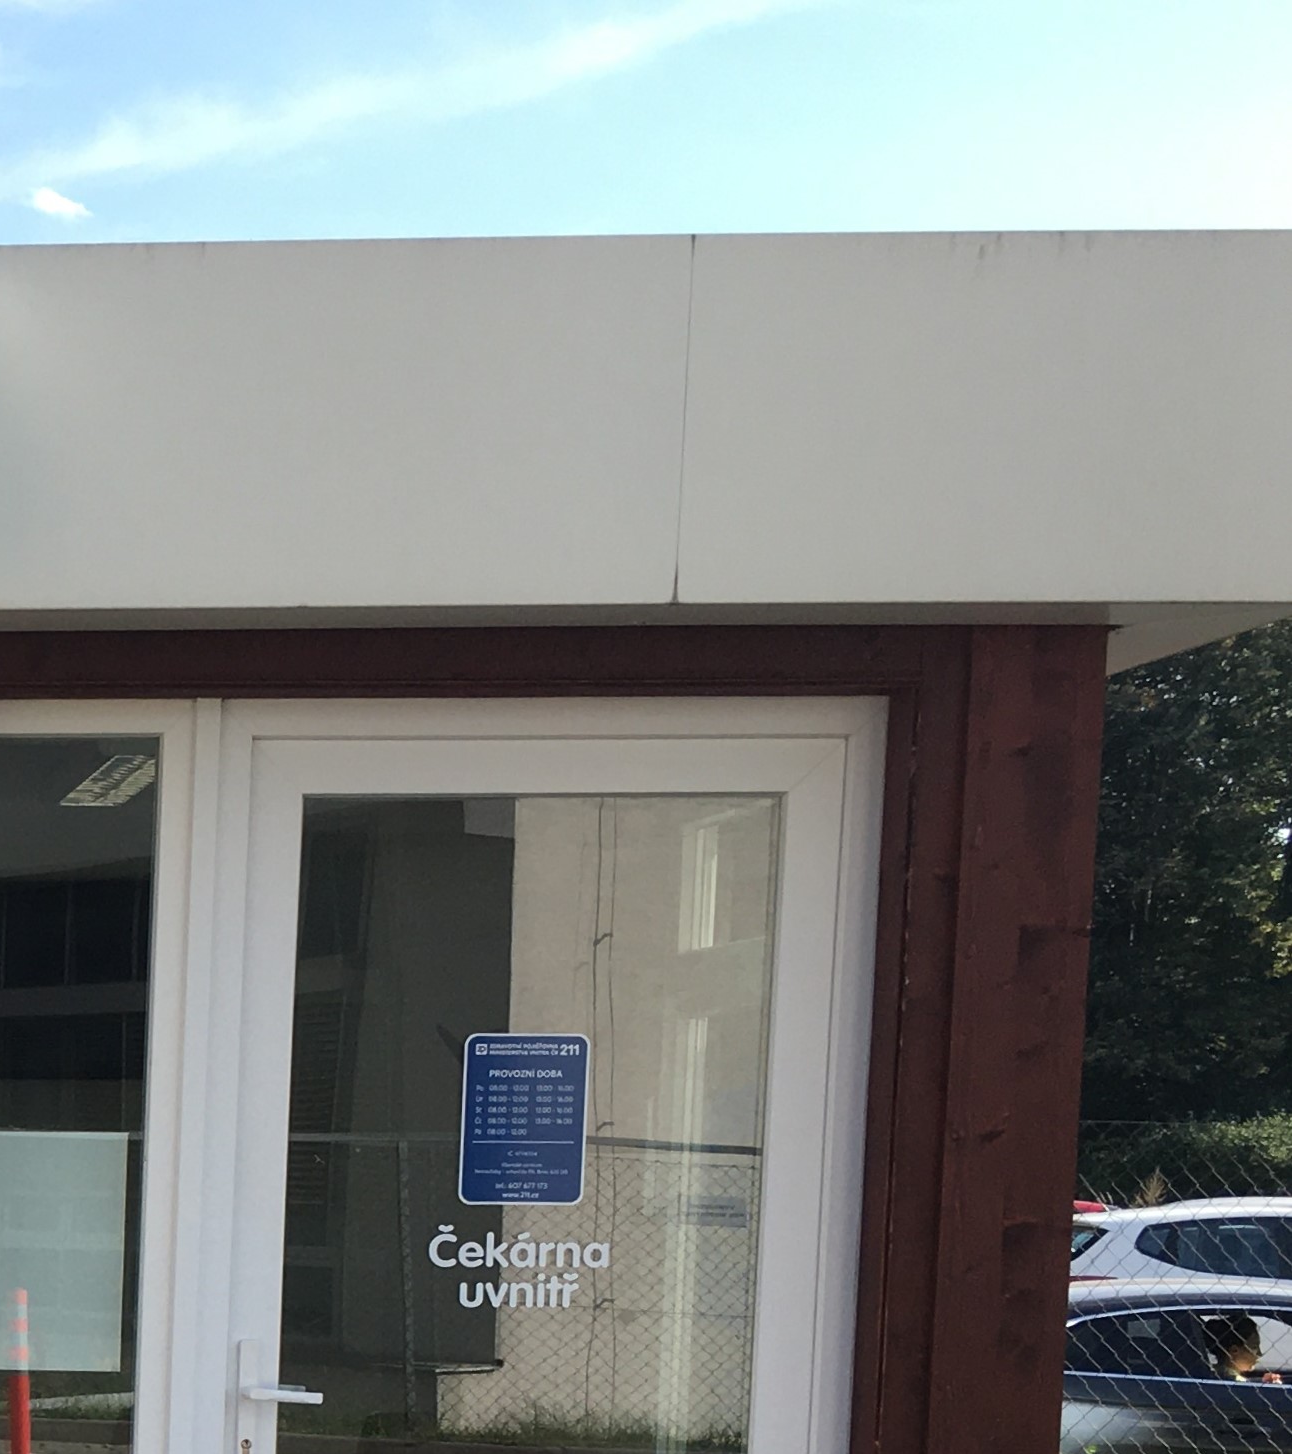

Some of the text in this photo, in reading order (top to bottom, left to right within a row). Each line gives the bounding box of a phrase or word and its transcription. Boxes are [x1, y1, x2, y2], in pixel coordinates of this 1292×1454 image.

[559, 1044, 580, 1056] 211
[488, 1068, 563, 1078] PROVOZNÍ DOBA
[428, 1224, 611, 1268] Čekárna
[458, 1273, 580, 1308] uvnitř
